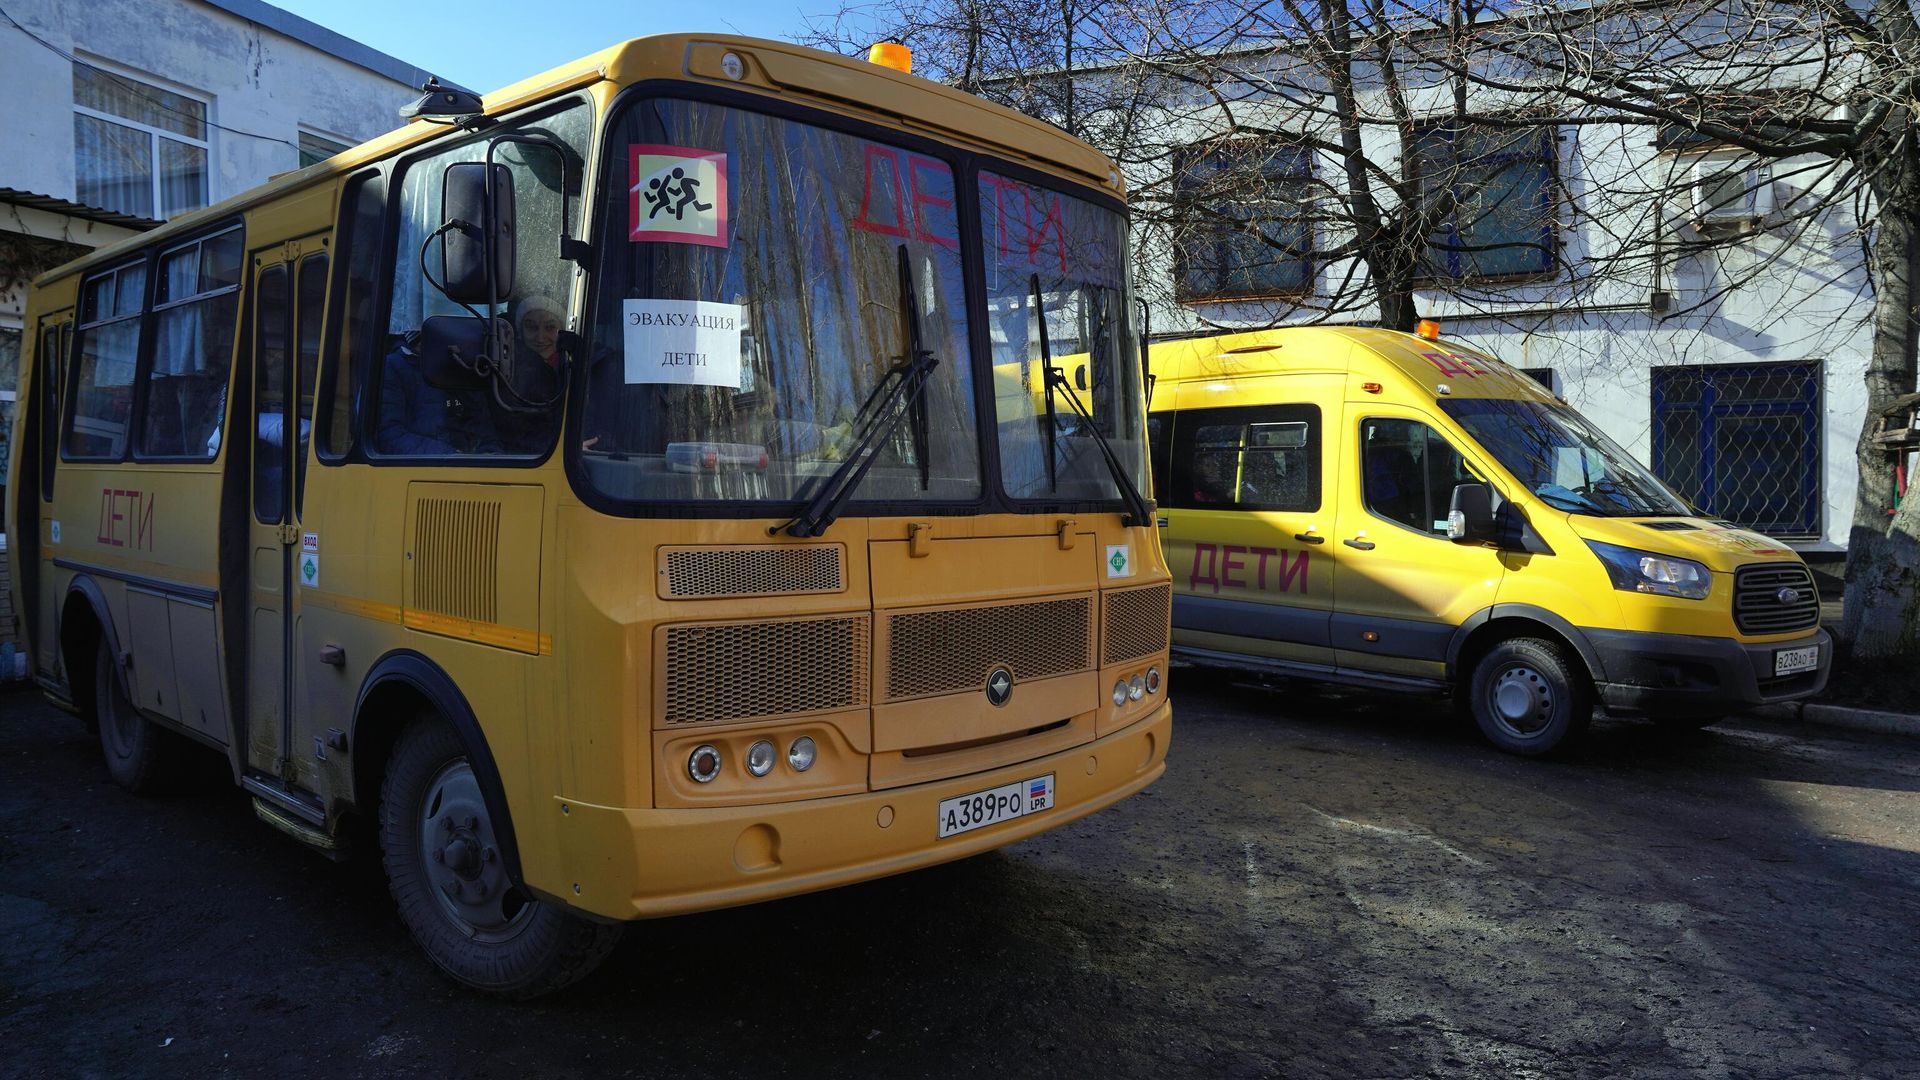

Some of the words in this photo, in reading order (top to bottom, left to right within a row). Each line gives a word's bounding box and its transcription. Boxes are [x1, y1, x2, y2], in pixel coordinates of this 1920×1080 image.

[852, 144, 1066, 273] ДЕТИ
[629, 312, 734, 331] ЭВАКУАЦИЯ
[661, 351, 707, 367] ДЕТИ
[97, 488, 155, 553] ДЕТИ
[1189, 543, 1310, 594] ДЕТИ
[945, 793, 1021, 832] А389РО
[1030, 797, 1046, 811] LPR
